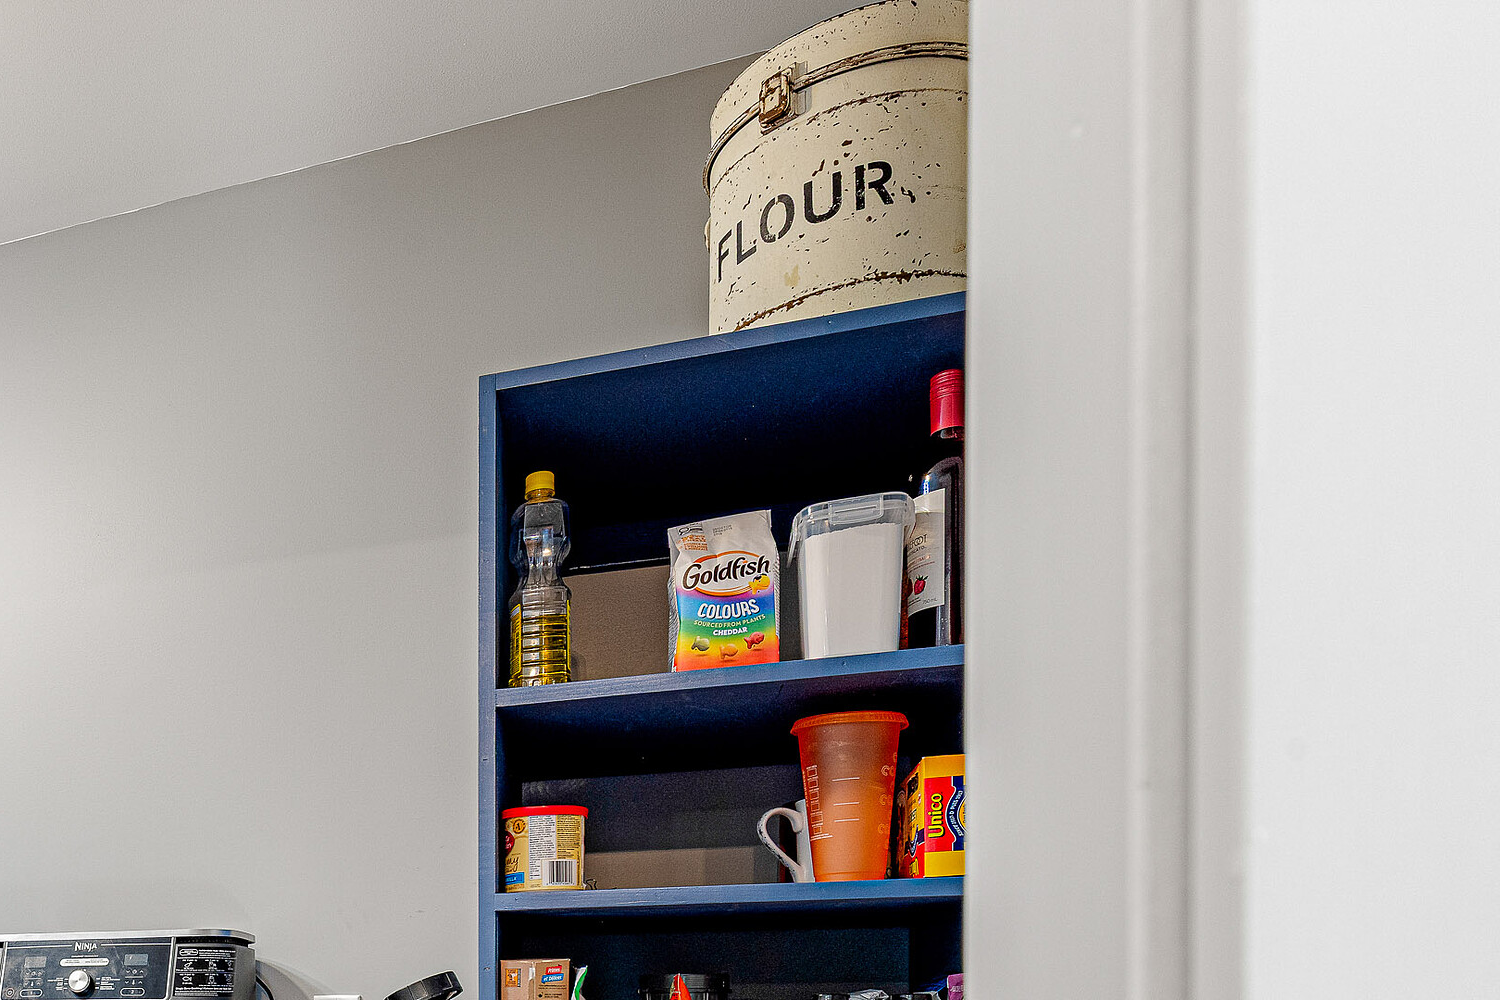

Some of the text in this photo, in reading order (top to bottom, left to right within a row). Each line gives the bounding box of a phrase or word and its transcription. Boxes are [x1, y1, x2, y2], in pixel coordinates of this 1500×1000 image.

[717, 161, 894, 283] FLOUR
[682, 555, 770, 590] Goldfish
[697, 598, 760, 620] COLOURS
[694, 614, 766, 628] SOURCED FROM PLANTS
[713, 626, 748, 636] CHEDDAR
[928, 792, 945, 838] Unico
[74, 942, 98, 953] NINJA
